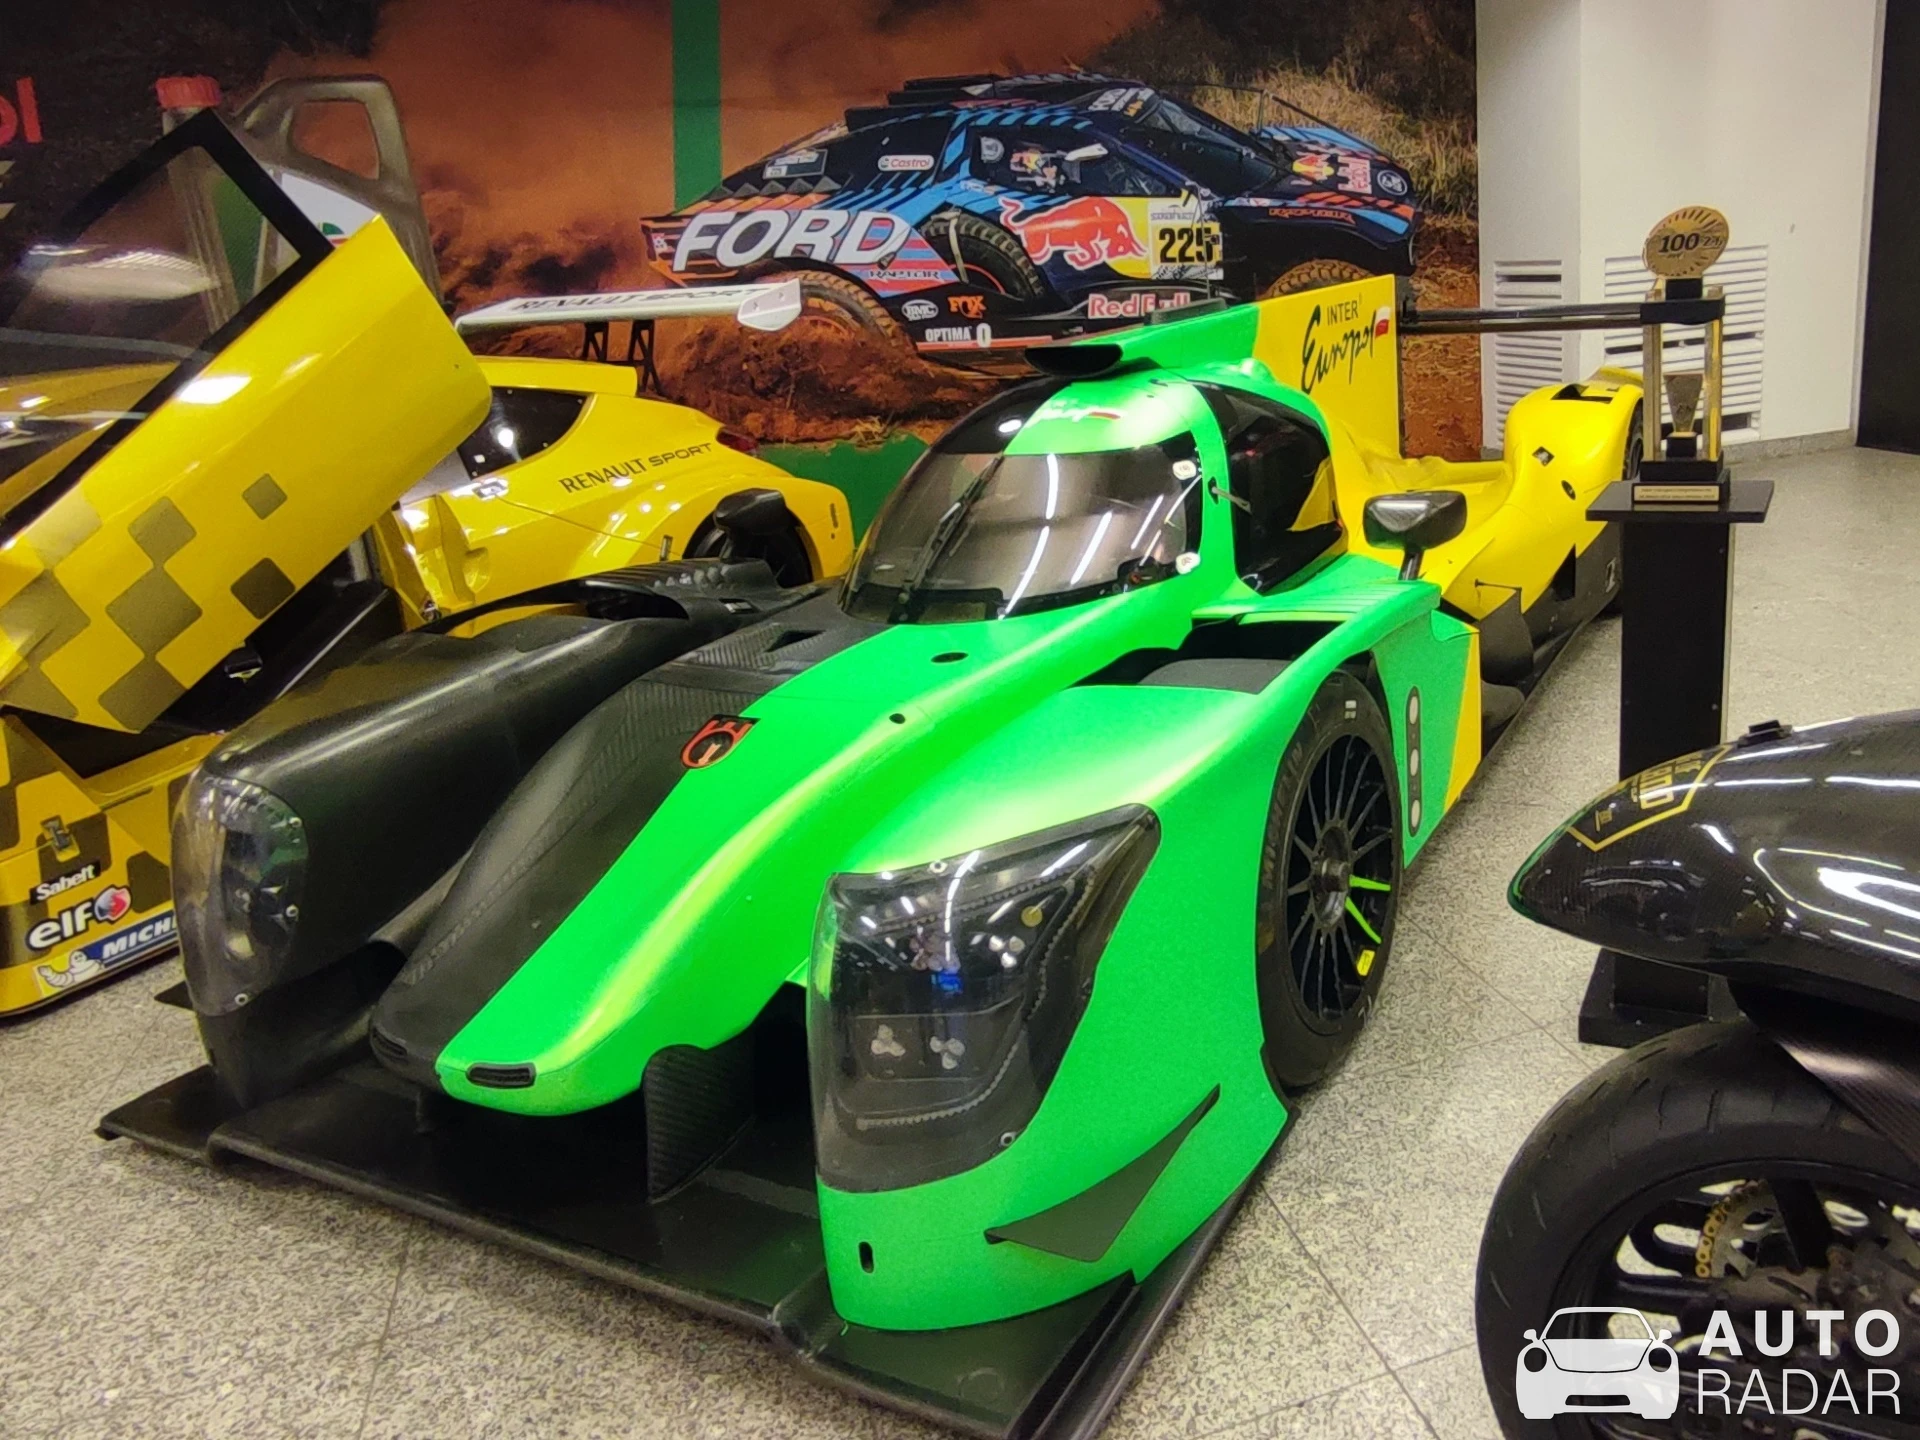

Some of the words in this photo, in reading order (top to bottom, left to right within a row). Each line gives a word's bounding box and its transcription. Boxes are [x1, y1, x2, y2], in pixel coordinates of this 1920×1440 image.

[890, 156, 931, 169] Castrol
[673, 209, 912, 271] FORD
[1159, 227, 1214, 263] 225
[1658, 233, 1700, 253] 100
[868, 269, 941, 283] RAPTOR
[514, 293, 640, 311] RENAULT
[948, 295, 986, 318] FOX
[1088, 293, 1140, 318] Red
[925, 328, 971, 342] OPTIMA
[559, 458, 647, 493] RENAULT
[648, 443, 711, 467] SPORT
[36, 864, 95, 901] Sabelt
[28, 901, 93, 949] elf
